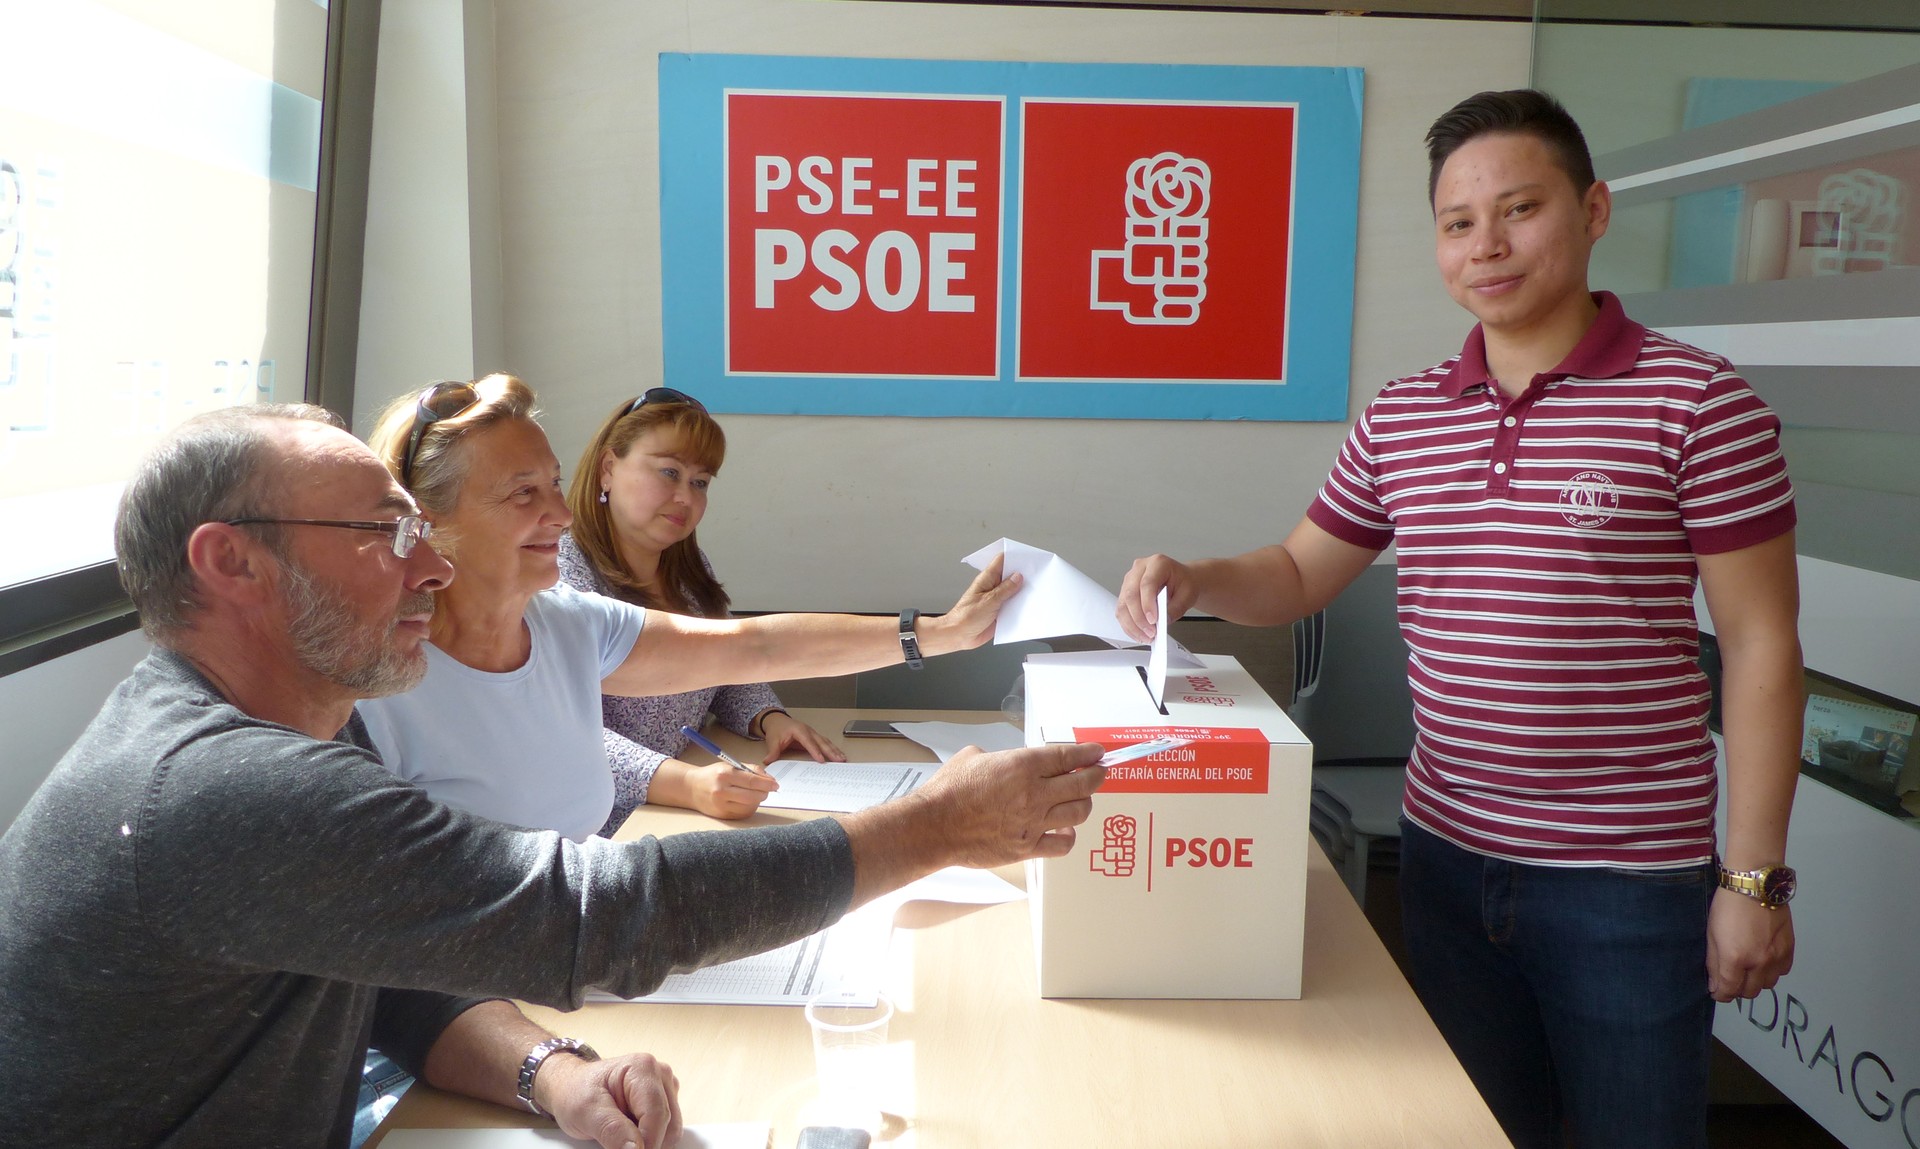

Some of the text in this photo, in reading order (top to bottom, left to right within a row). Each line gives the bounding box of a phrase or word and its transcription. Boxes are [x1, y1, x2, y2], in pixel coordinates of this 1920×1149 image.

[755, 155, 977, 217] PSE-EE
[755, 229, 976, 313] PSOE
[1105, 765, 1253, 780] CRETARÍA GENERAL DEL PSOE
[1147, 747, 1196, 762] ELECCIÓN
[1165, 837, 1254, 868] PSOE
[1733, 987, 1920, 1149] DRAG
